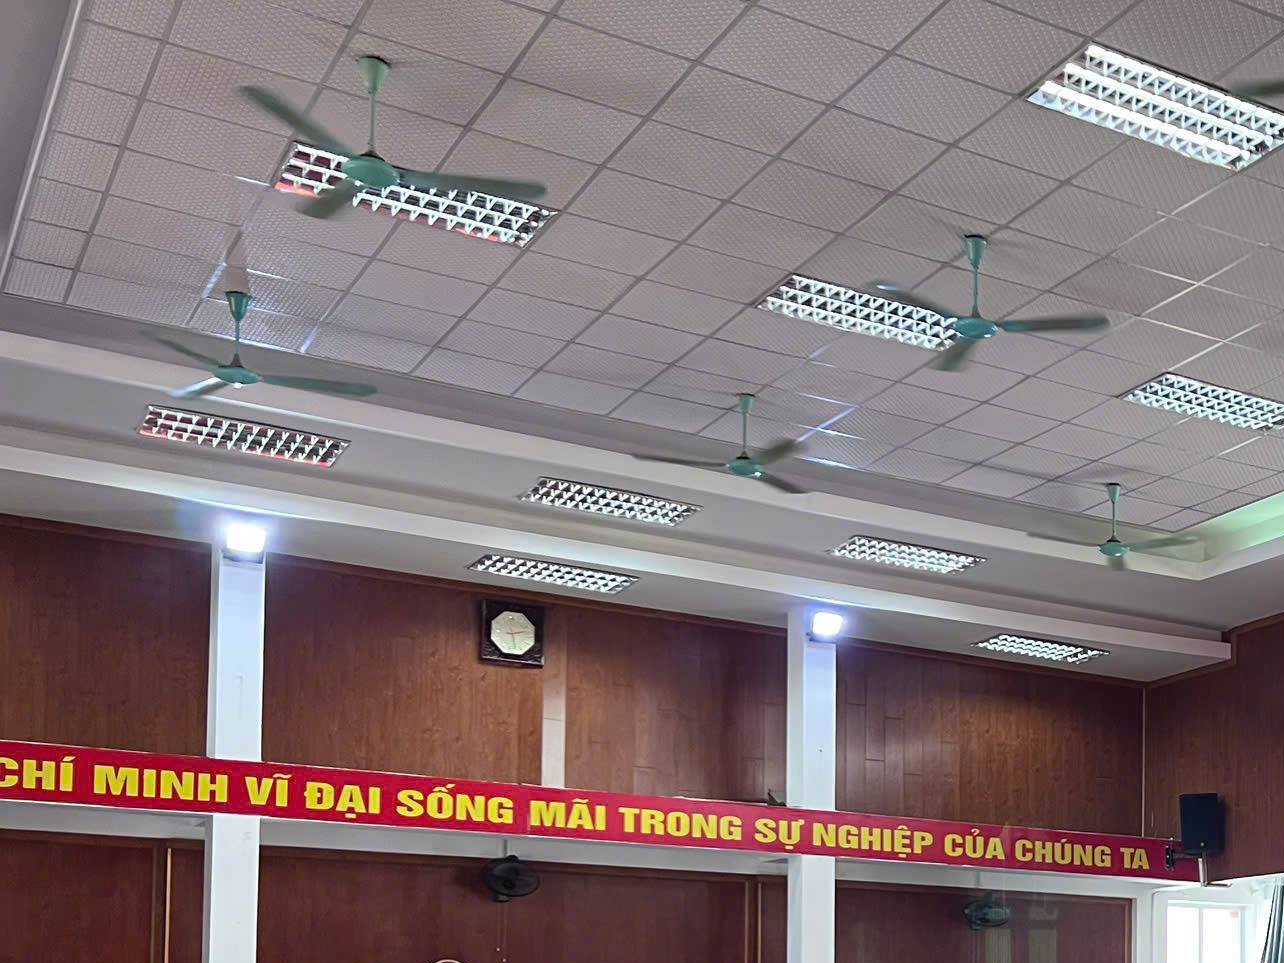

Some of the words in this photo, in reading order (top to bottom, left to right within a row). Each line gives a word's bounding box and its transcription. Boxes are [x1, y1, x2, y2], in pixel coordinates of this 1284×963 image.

[0, 756, 76, 792] CHÍ
[94, 765, 228, 803] MINH
[245, 772, 293, 807] VĨ
[304, 780, 381, 819] ĐẠI
[396, 783, 514, 824] SỐNG
[530, 798, 606, 831] MÃI
[618, 807, 742, 841] TRONG
[754, 816, 805, 853] SỰ
[812, 823, 934, 858] NGHIỆP
[944, 827, 1006, 861] CỦA
[1015, 837, 1112, 868] CHÚNG
[1120, 846, 1150, 870] TA
